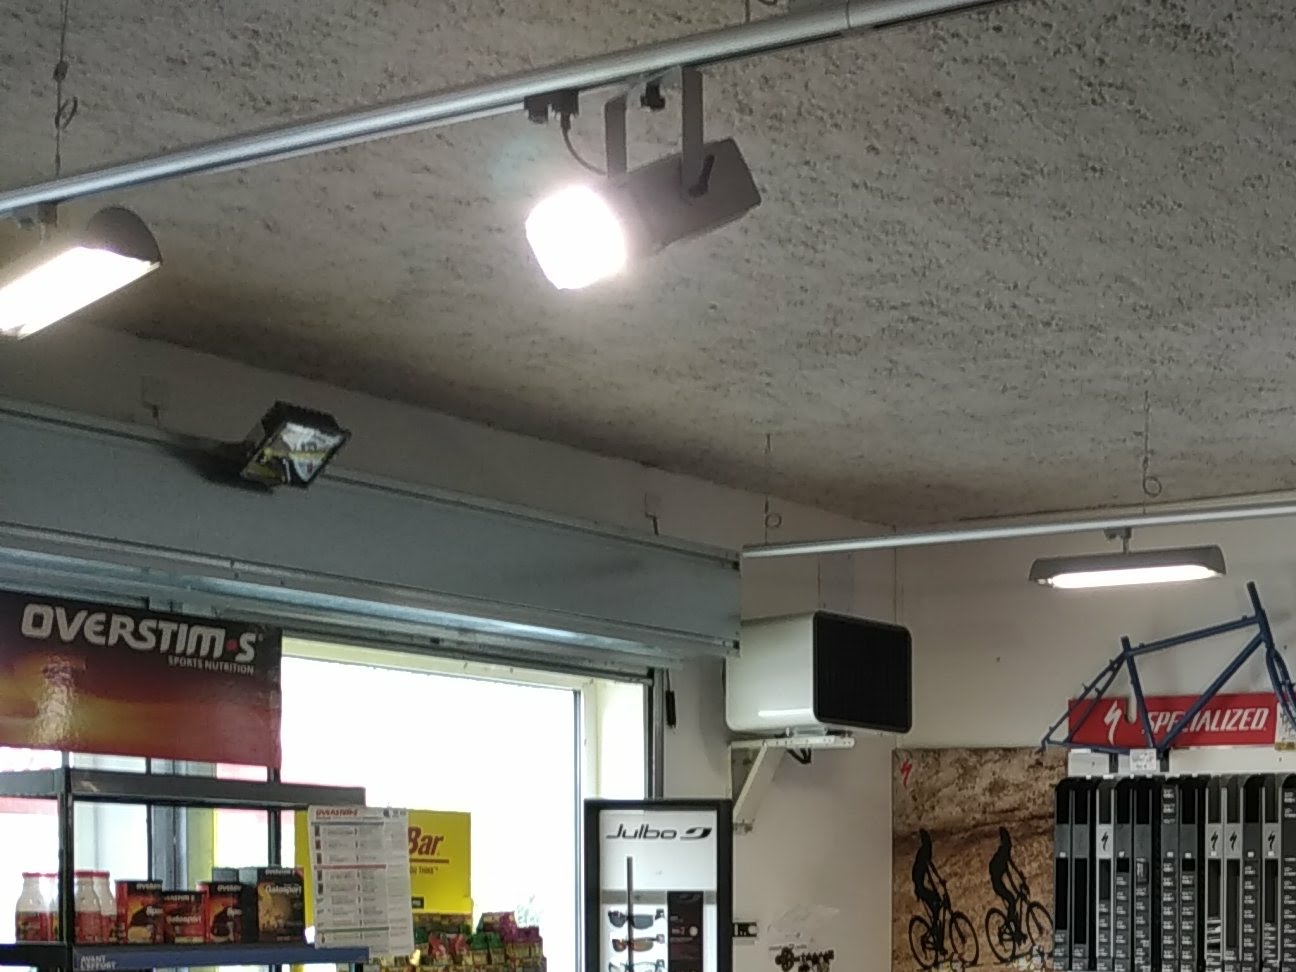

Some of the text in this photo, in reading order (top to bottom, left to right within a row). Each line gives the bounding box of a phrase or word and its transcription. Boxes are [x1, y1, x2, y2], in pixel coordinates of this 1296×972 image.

[169, 655, 254, 675] SPORTS NUTRITION
[606, 823, 678, 840] Julbo
[80, 955, 106, 964] AVANT
[80, 962, 116, 971] L'EFFORT
